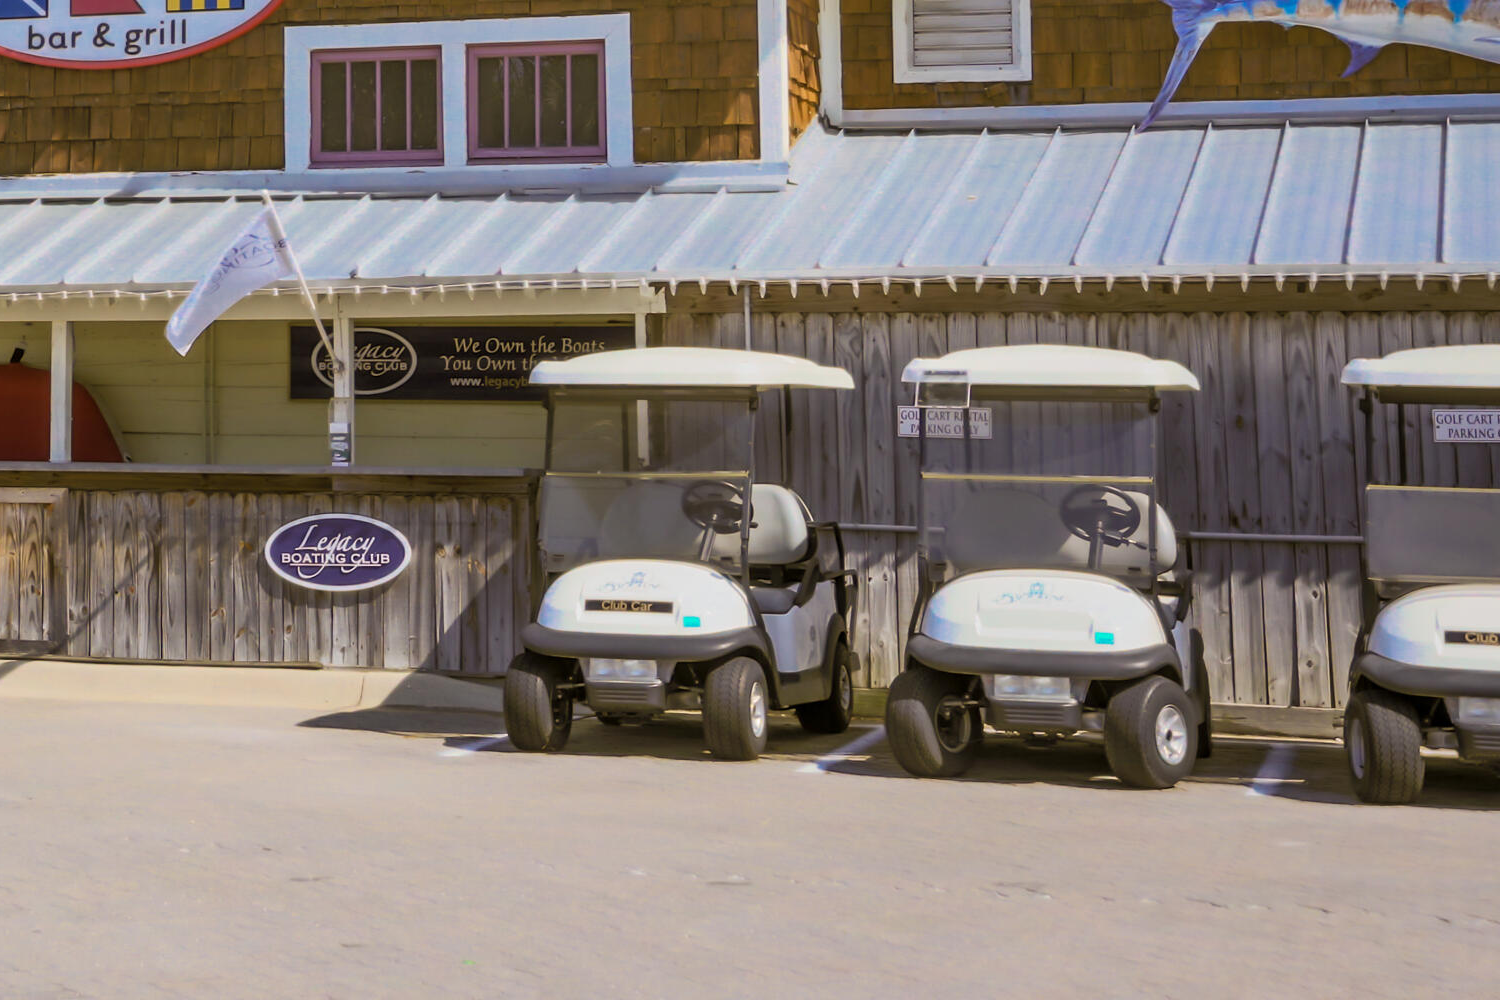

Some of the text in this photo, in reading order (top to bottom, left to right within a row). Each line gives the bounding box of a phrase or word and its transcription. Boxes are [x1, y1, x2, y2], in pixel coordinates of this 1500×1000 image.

[27, 19, 187, 55] bar & grill
[453, 335, 605, 353] We Own the Boats
[375, 362, 408, 371] CLUB
[439, 355, 473, 371] You
[476, 355, 517, 371] Own
[522, 353, 539, 371] th
[450, 375, 529, 389] www.legacyb
[900, 410, 921, 420] GOL
[927, 411, 951, 420] CART
[1436, 414, 1463, 424] GOLF
[1466, 414, 1493, 424] CART
[1448, 428, 1495, 438] PARKING
[295, 524, 375, 571] Legacy
[281, 553, 391, 564] BOATING CLUB
[601, 600, 653, 611] Club Car
[1464, 632, 1499, 643] Club
